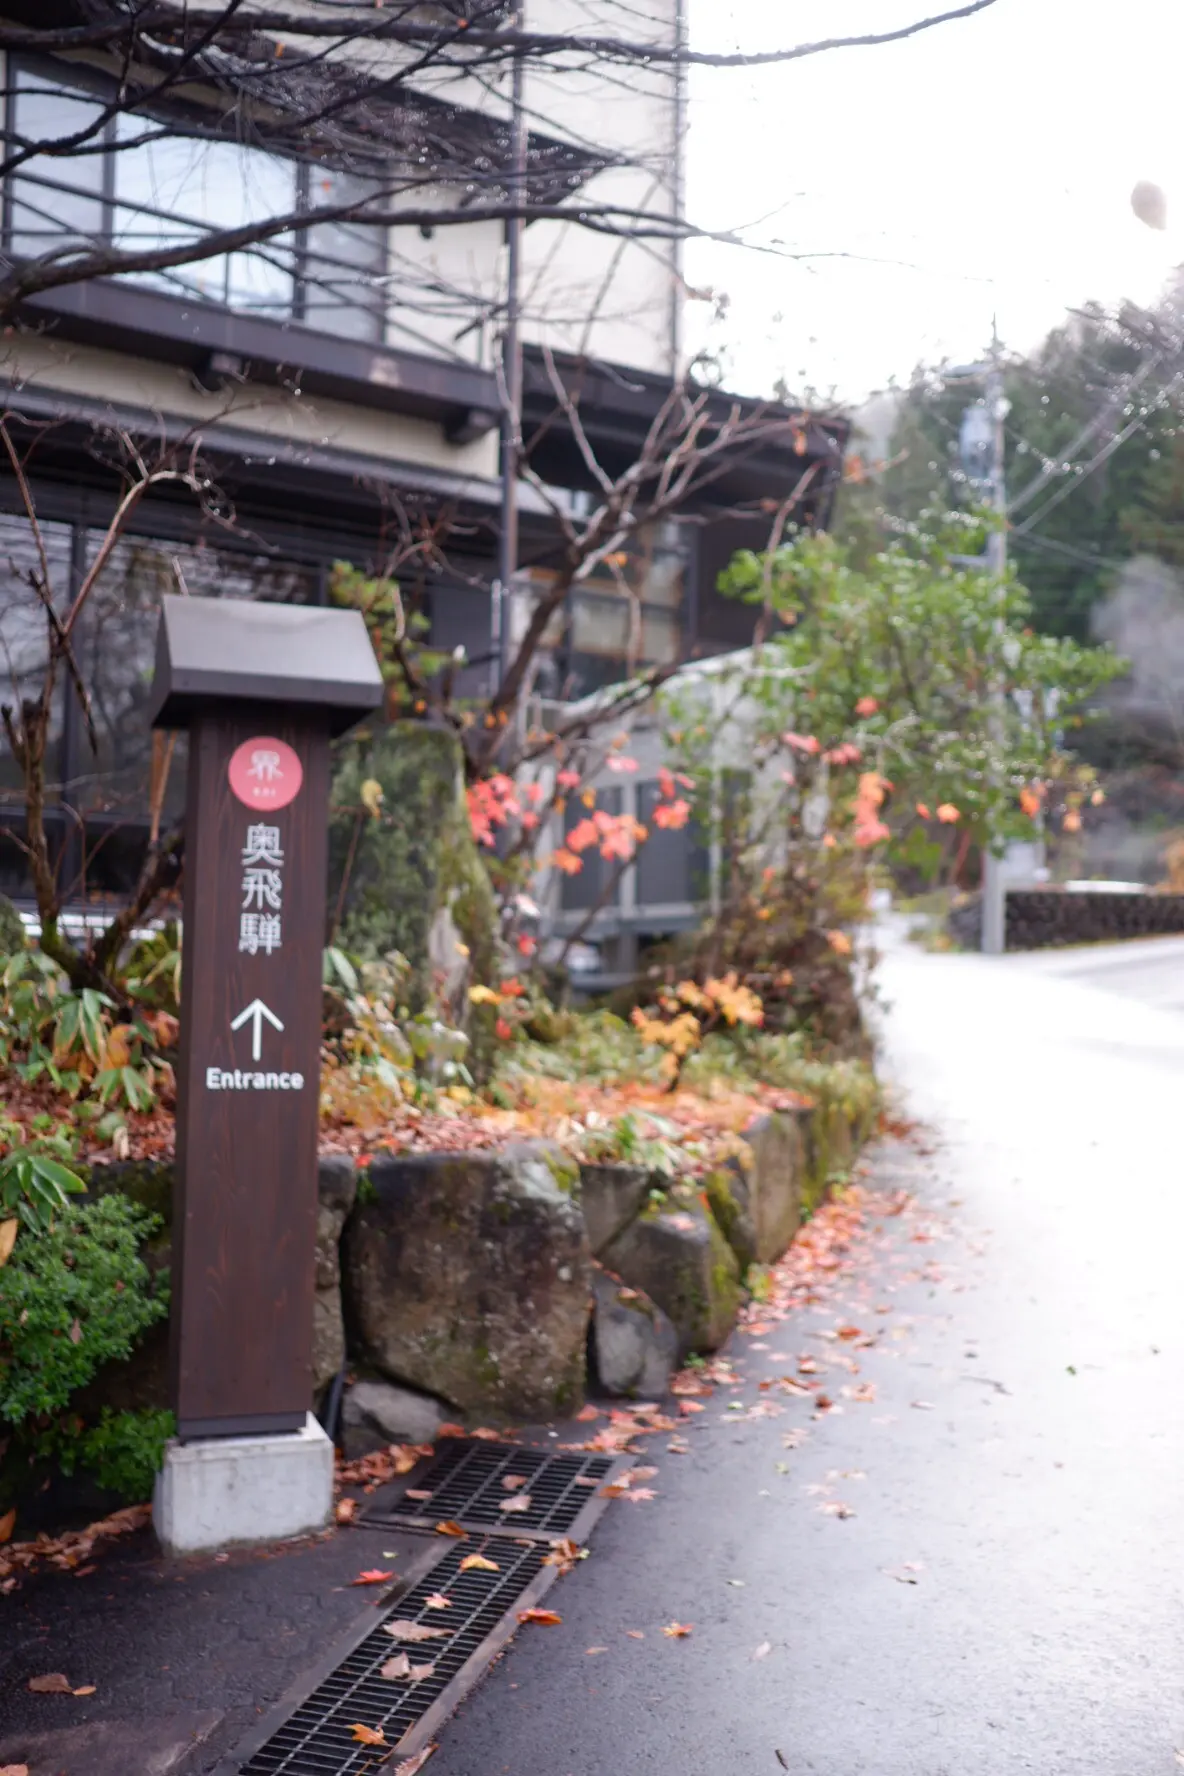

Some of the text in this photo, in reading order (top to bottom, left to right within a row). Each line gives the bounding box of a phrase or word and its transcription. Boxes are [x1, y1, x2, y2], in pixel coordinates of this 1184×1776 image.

[238, 822, 284, 956] 奥飛騨
[206, 1067, 304, 1090] Entrance
